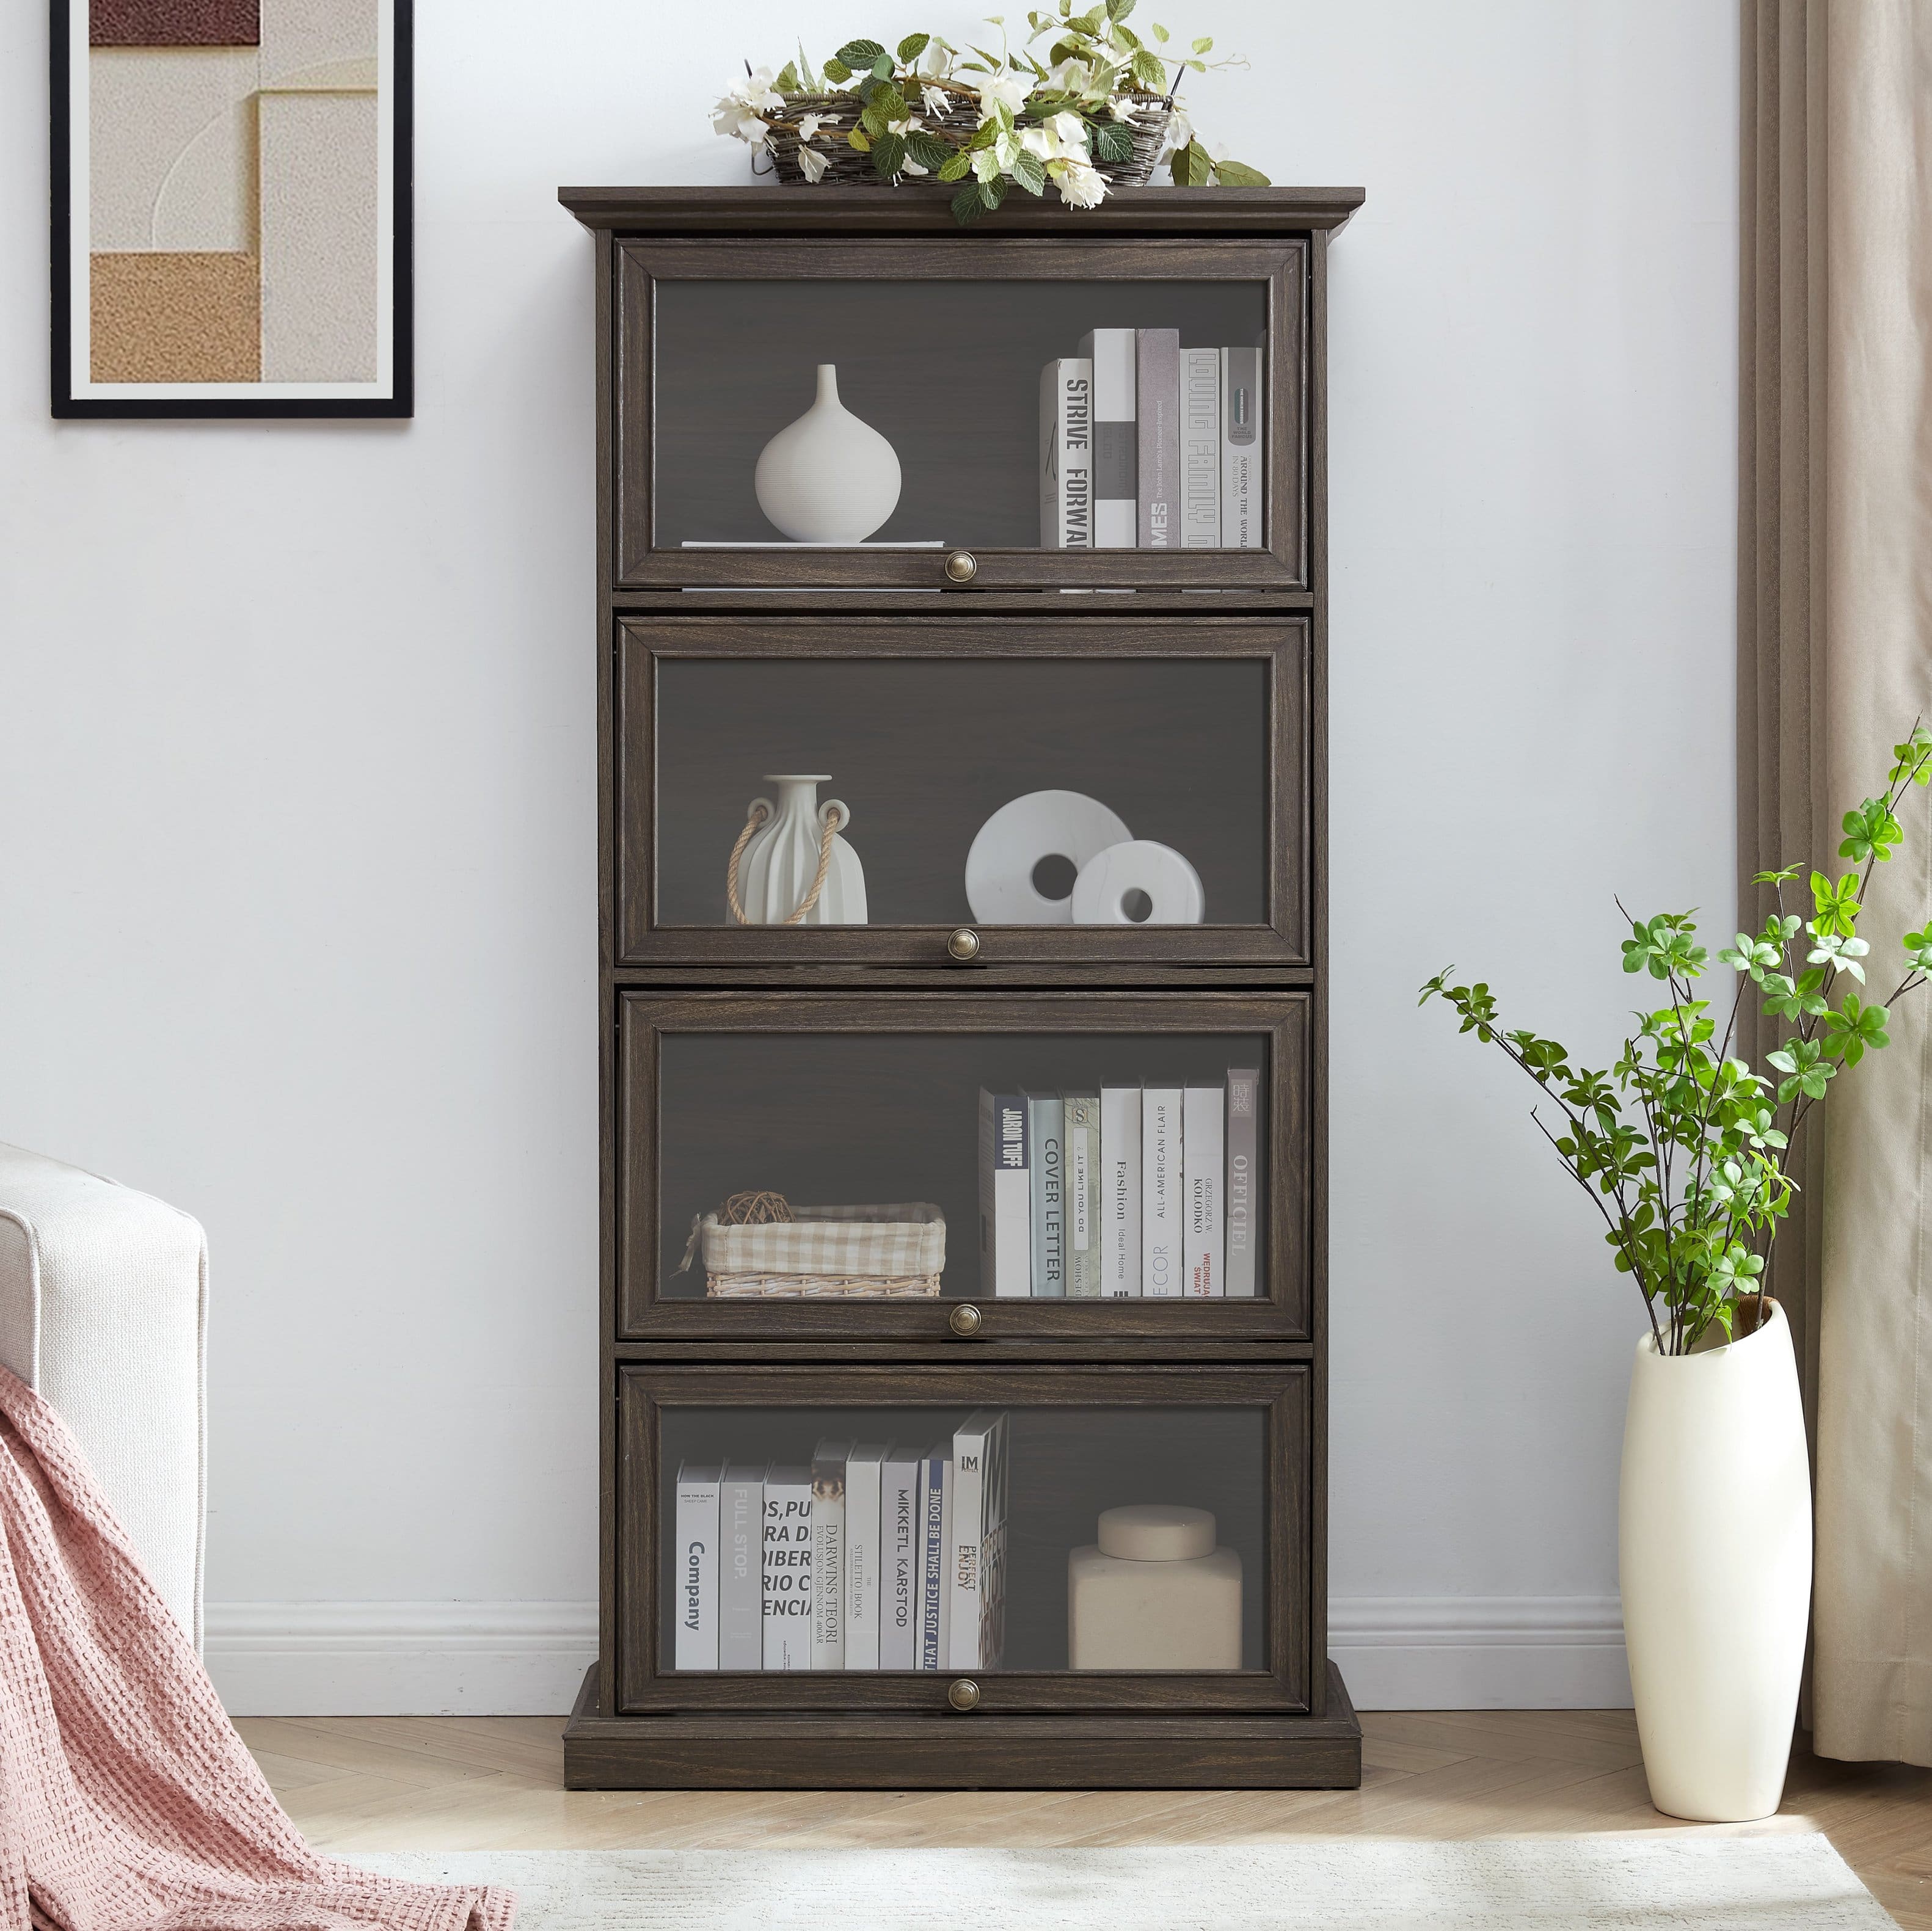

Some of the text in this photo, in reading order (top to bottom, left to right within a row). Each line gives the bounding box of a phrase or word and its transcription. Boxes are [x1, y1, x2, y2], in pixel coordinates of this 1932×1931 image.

[1066, 379, 1088, 548] STRIVE FORWA
[1188, 440, 1216, 523] FAMILY
[1232, 456, 1239, 464] IN
[1232, 466, 1239, 476] 80
[1002, 1108, 1023, 1166] JARON TUFF
[1077, 1155, 1084, 1164] IT
[1117, 1161, 1127, 1220] Fashion
[1157, 1139, 1165, 1218] ALL-AMERICAN
[1044, 1138, 1060, 1281] COVER LETTER
[1078, 1218, 1084, 1232] DO
[1194, 1179, 1203, 1234] KOLODKO
[1231, 1155, 1248, 1256] OFFICIEL
[1205, 1224, 1212, 1234] W.
[1153, 1245, 1168, 1296] ECOR
[1194, 1267, 1203, 1294] ŚWIAT
[1201, 1253, 1211, 1296] WĘDRUJĄ
[961, 1456, 978, 1469] IM
[930, 1488, 941, 1521] DONE
[734, 1489, 748, 1579] FULL STOP.
[764, 1526, 811, 1541] RA D
[815, 1526, 823, 1574] EVOLUSJON
[928, 1525, 940, 1539] BE
[895, 1489, 909, 1627] MIKKETL KARSTOD
[927, 1542, 939, 1579] SHALL
[958, 1545, 969, 1591] ENJOY
[968, 1545, 977, 1591] PERFECT
[684, 1541, 705, 1631] Company
[815, 1576, 824, 1618] GJENNOM
[825, 1524, 837, 1643] DARWINS TEORI
[854, 1593, 862, 1619] BOOK
[926, 1584, 938, 1635] JUSTICE
